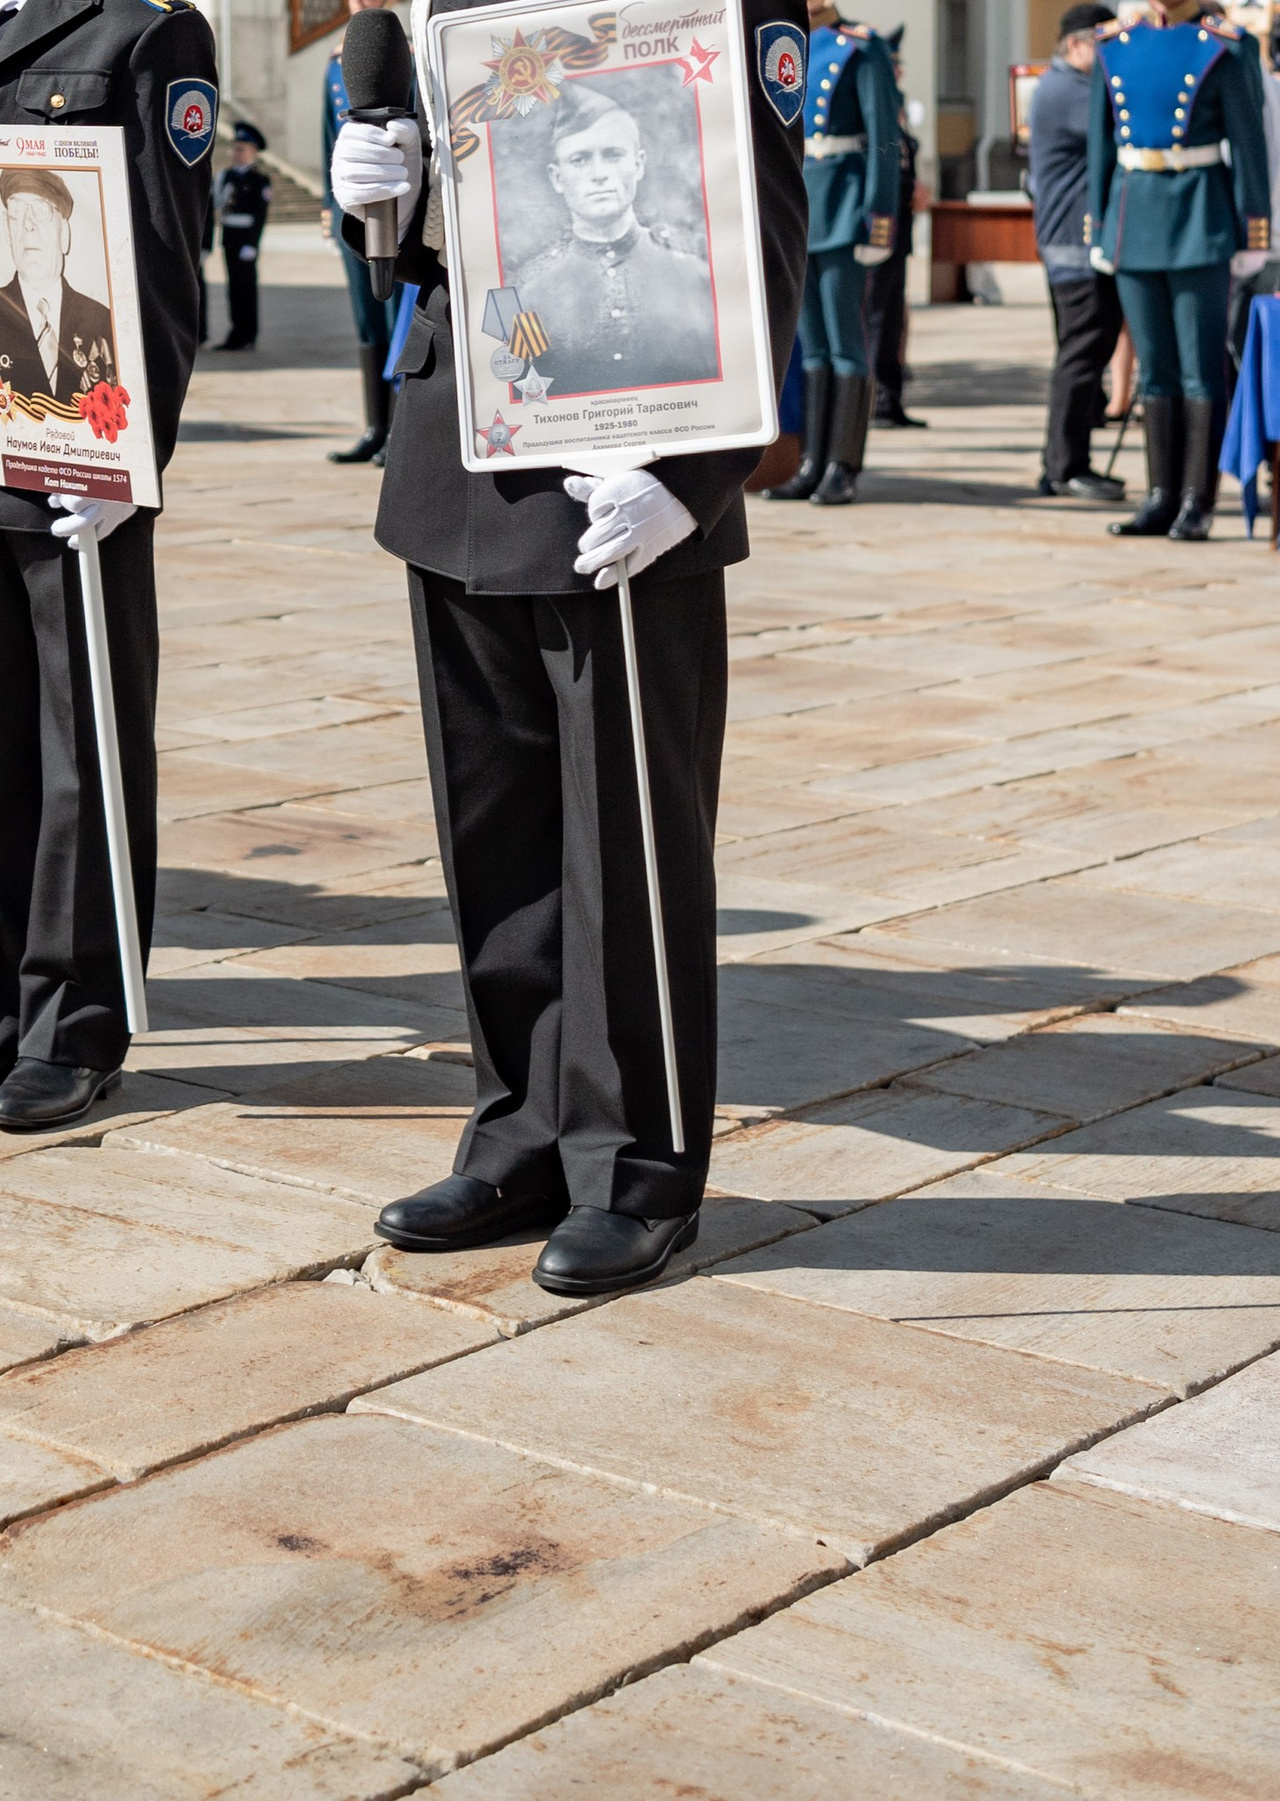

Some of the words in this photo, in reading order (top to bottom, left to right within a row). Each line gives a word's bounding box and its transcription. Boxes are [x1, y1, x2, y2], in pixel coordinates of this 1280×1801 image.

[623, 36, 680, 60] ПОЛК
[16, 137, 25, 156] 9
[25, 139, 45, 150] МАЯ
[54, 147, 100, 159] ПОБЕДЫ!
[533, 412, 580, 425] Тихонов
[582, 403, 634, 421] Григорий
[636, 400, 698, 415] Тарасович
[45, 427, 76, 441] Рядовой
[564, 434, 611, 444] воспитанника
[612, 430, 648, 439] кадетского
[649, 428, 673, 436] класса
[674, 425, 690, 433] ФСО
[691, 423, 716, 432] России
[594, 419, 638, 431] 1925-1980
[6, 436, 38, 451] Наумов
[39, 441, 61, 454] Иван
[63, 443, 121, 461] Дмитриевич
[58, 467, 72, 477] ФСО
[72, 468, 91, 479] России
[92, 472, 112, 481] школы
[112, 473, 128, 484] 1574
[60, 479, 88, 492] Никиты
